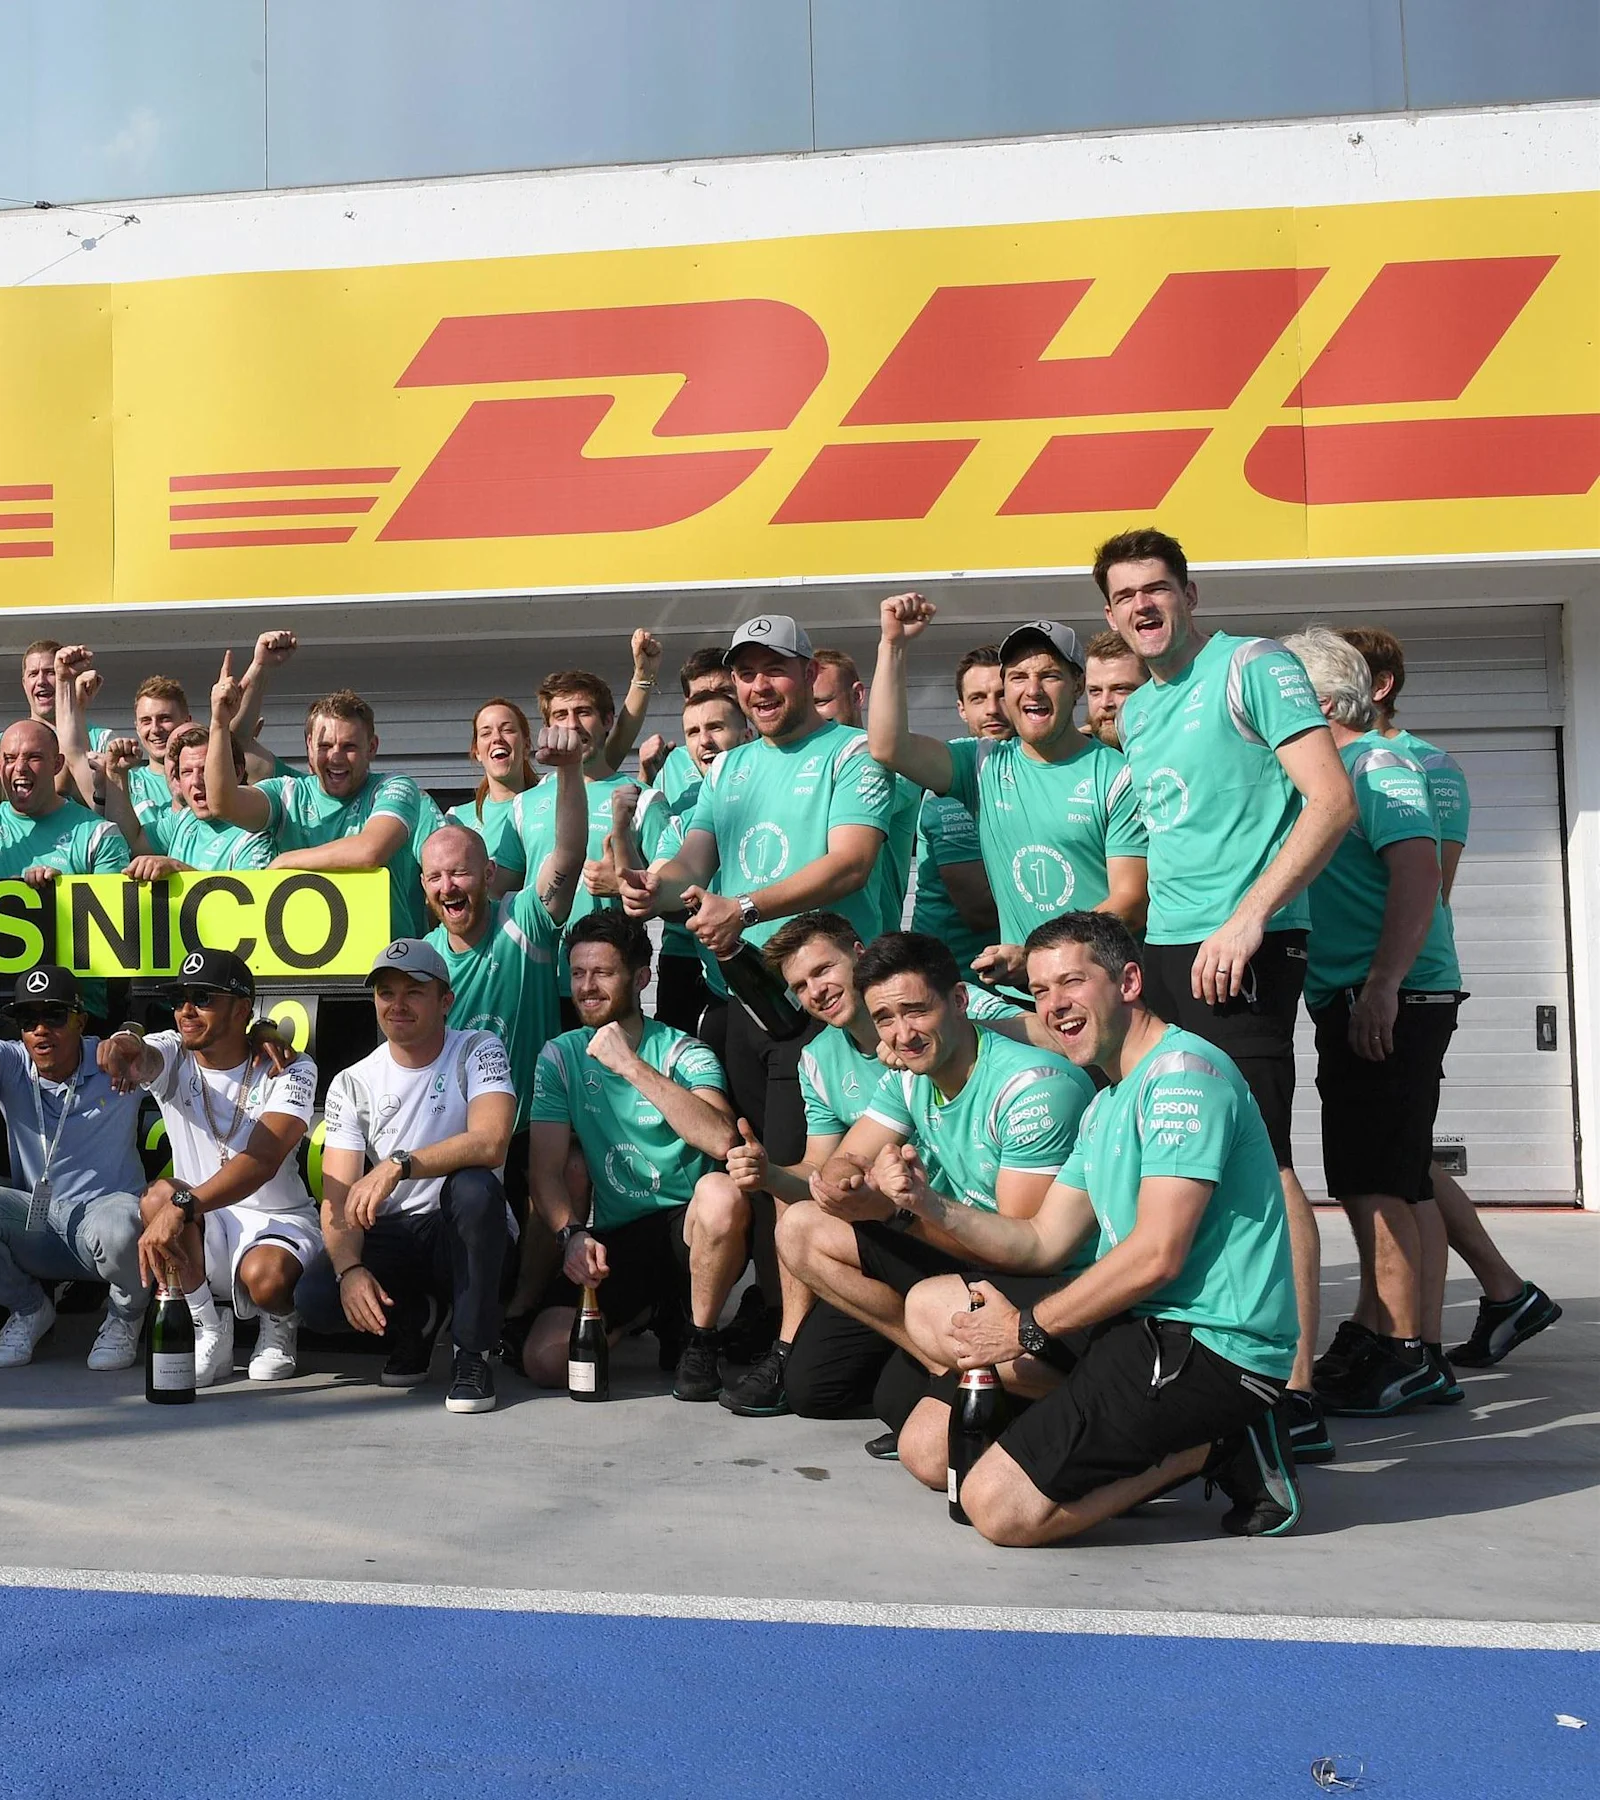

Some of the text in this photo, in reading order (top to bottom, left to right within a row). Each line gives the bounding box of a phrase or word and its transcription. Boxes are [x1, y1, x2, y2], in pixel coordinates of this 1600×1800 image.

[375, 254, 1600, 542] DHL
[1386, 788, 1422, 797] EPSON
[1433, 788, 1459, 798] PSON
[1067, 813, 1091, 822] BOSS
[756, 835, 769, 869] 1
[1016, 845, 1063, 861] GP WINNERS
[753, 875, 769, 884] 2016
[1030, 859, 1048, 896] 1
[1035, 902, 1056, 912] 2016
[71, 874, 349, 970] NICO
[1152, 1087, 1203, 1100] QUALCOMM
[1008, 1104, 1049, 1125] EPSON
[1153, 1102, 1198, 1115] EPSON
[638, 1116, 660, 1125] BOSS
[1150, 1119, 1184, 1130] Allianz
[1007, 1121, 1039, 1136] Allianz
[1157, 1132, 1186, 1146] IWC
[629, 1189, 650, 1198] 2016
